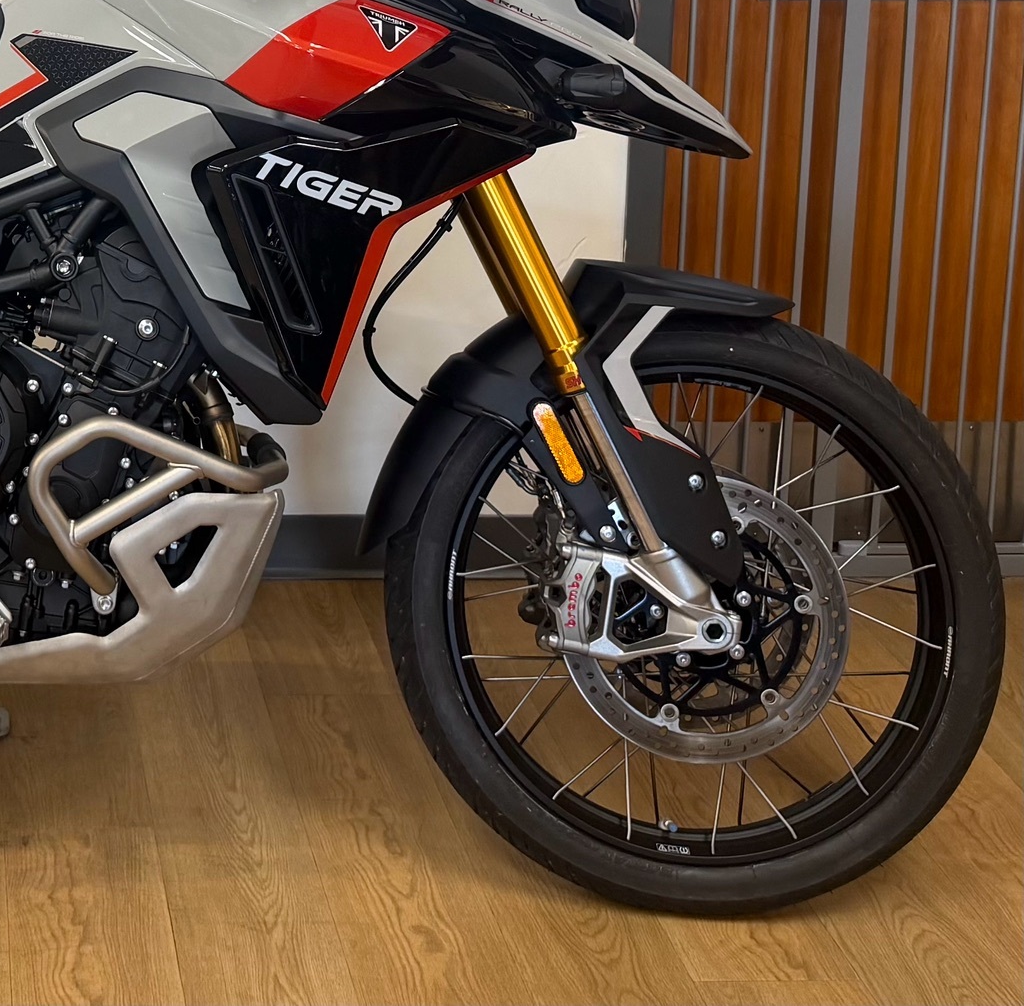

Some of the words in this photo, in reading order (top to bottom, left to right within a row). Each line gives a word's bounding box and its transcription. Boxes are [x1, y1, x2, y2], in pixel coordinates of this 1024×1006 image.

[369, 10, 406, 26] TRIUMPH
[498, 0, 548, 22] RALLY
[255, 152, 403, 217] TIGER
[564, 573, 583, 628] brembo
